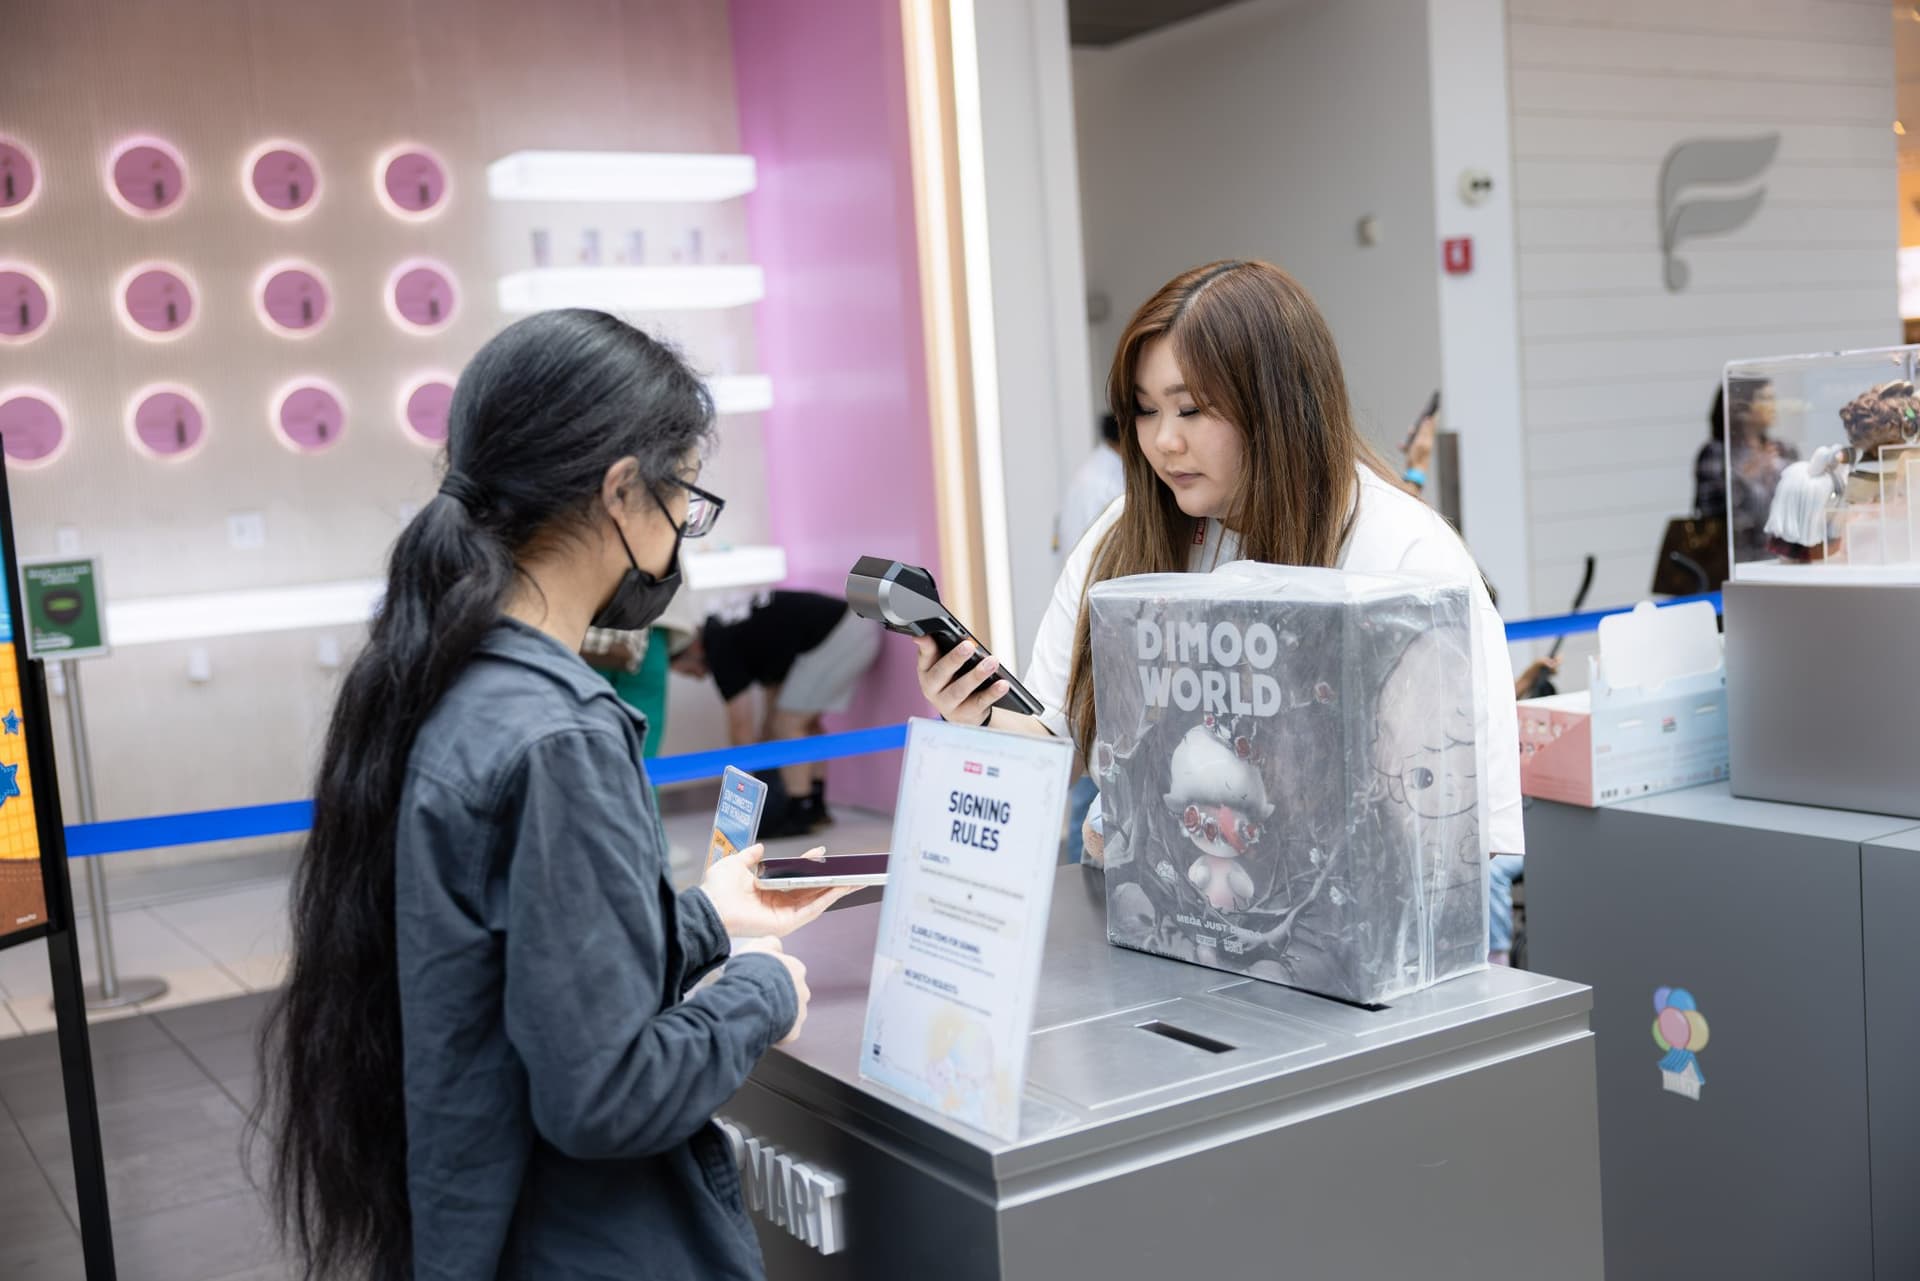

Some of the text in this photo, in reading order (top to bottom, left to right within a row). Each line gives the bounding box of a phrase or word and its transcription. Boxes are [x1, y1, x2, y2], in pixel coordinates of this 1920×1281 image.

[1136, 621, 1278, 668] DIMOO
[1138, 667, 1281, 717] WORLD
[948, 791, 1011, 825] SIGNING
[950, 820, 1000, 852] RULES
[1176, 914, 1202, 927] MEGA
[1204, 920, 1227, 932] JUST
[745, 1138, 838, 1255] MART
